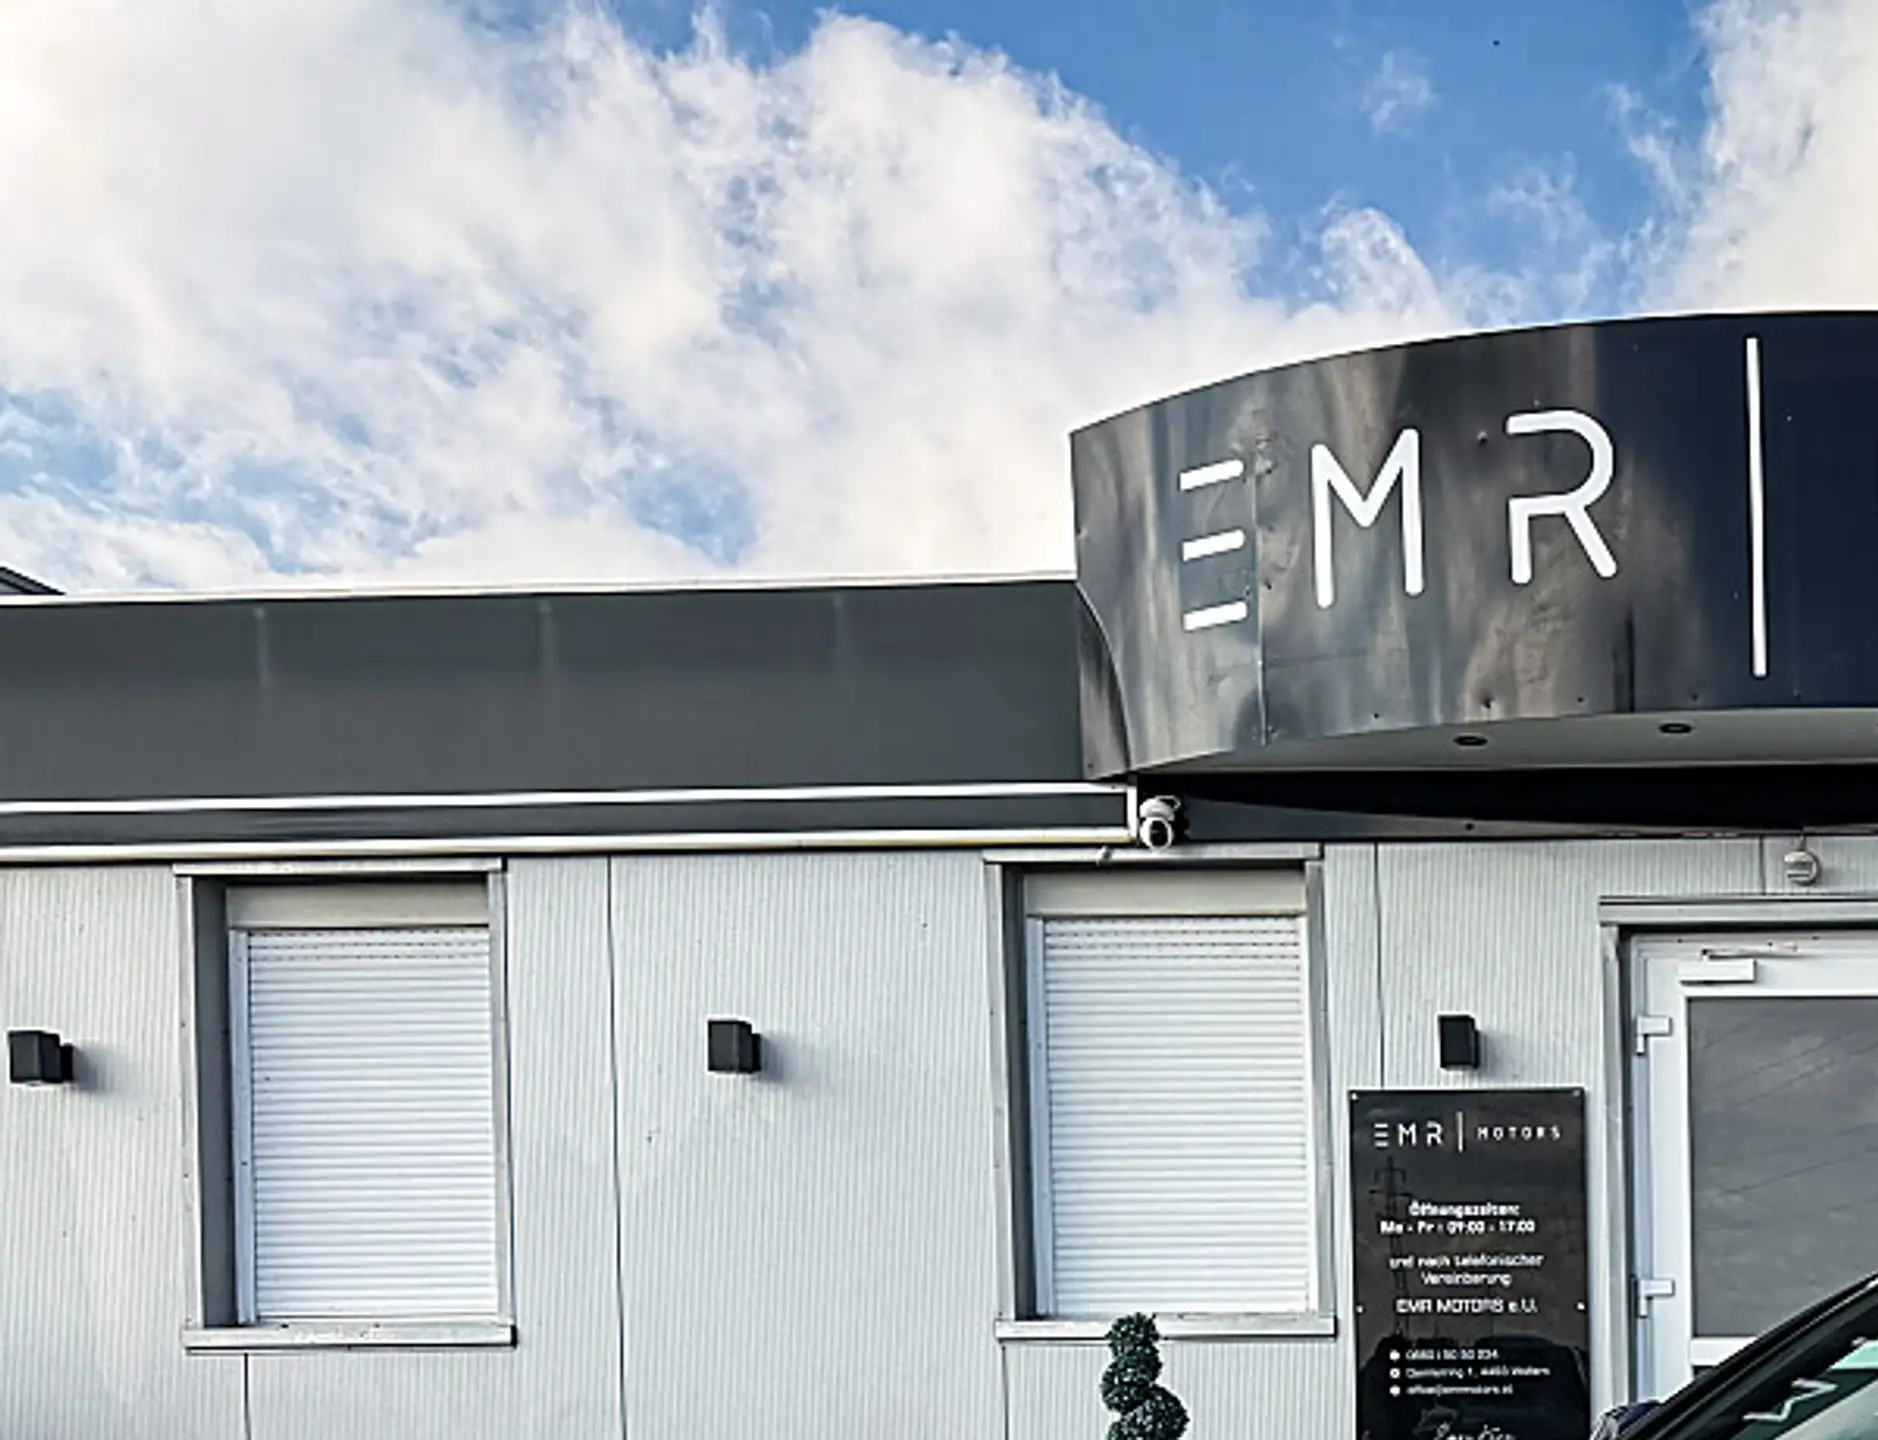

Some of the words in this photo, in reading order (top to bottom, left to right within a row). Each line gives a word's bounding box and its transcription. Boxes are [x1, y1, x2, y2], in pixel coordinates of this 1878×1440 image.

[1180, 409, 1619, 632] EMR
[1373, 1120, 1444, 1148] EMR
[1477, 1124, 1561, 1141] MOTORS
[1436, 1299, 1504, 1313] MOTORS
